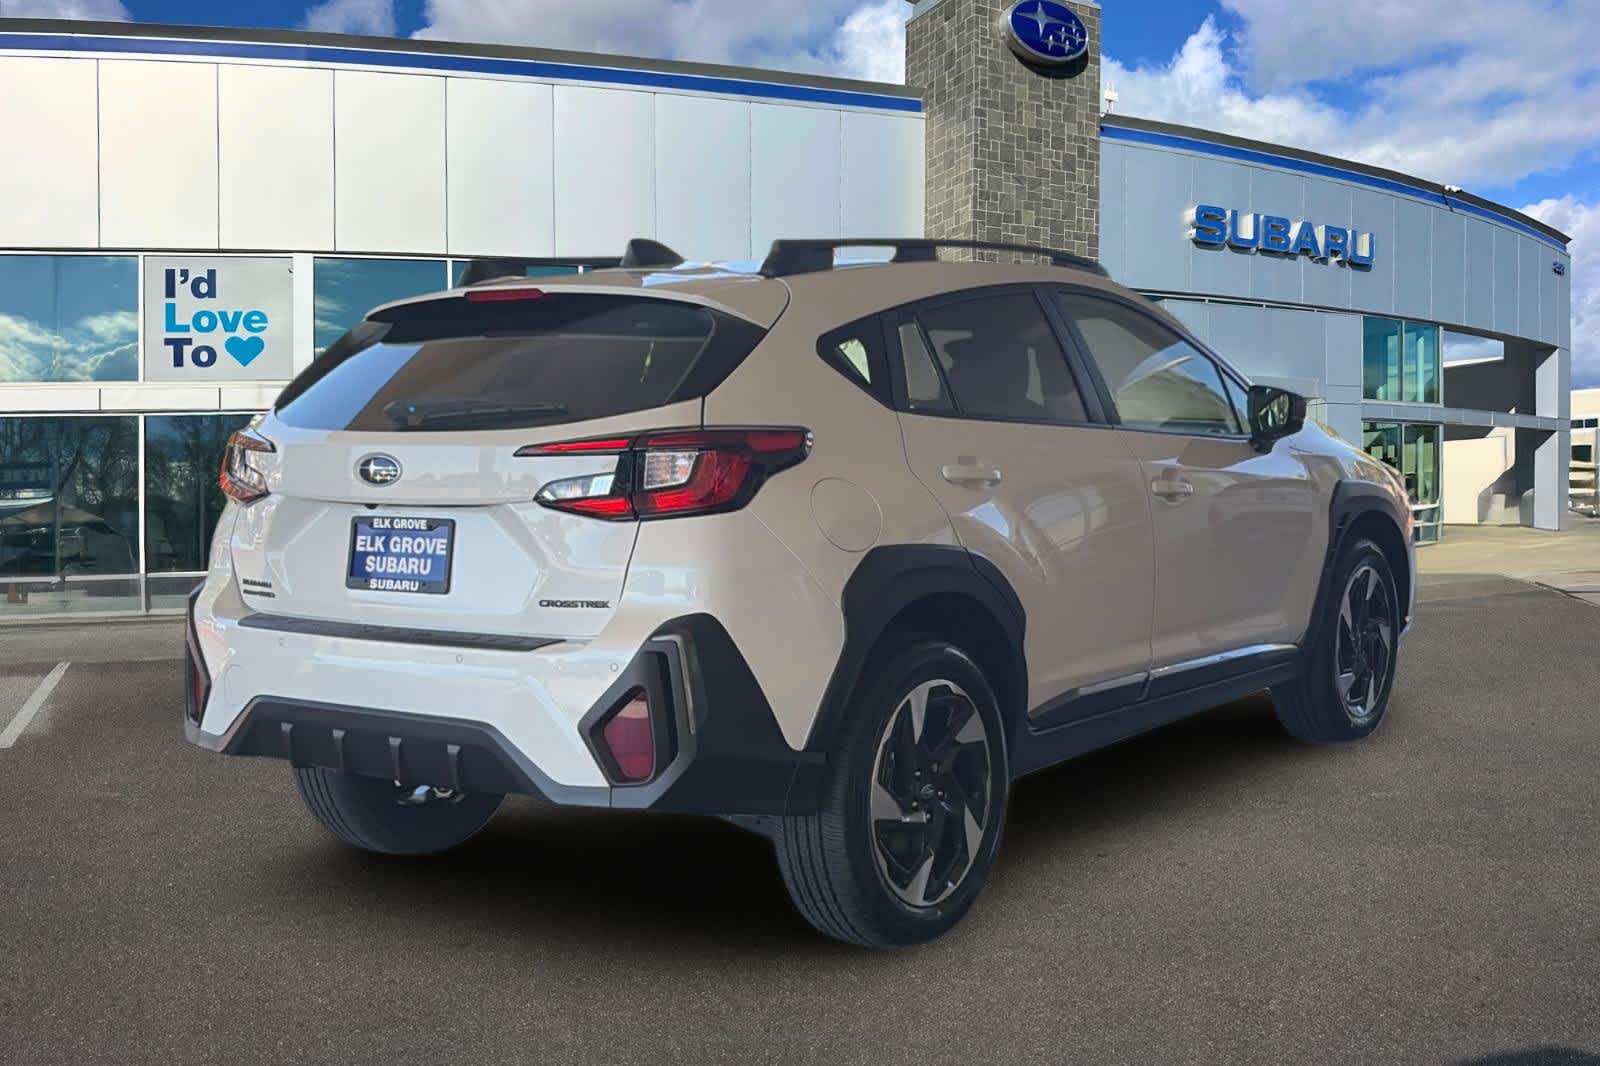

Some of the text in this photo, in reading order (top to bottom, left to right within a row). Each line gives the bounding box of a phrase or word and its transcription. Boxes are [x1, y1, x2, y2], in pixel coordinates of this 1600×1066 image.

[1189, 204, 1376, 272] SUBARU
[165, 302, 269, 333] Love
[163, 337, 218, 368] To
[373, 518, 427, 530] ELK GROVE
[356, 535, 448, 556] ELK GROVE
[365, 555, 432, 576] SUBARU
[369, 578, 419, 592] SUBARU
[539, 599, 611, 609] CROSSTREK
